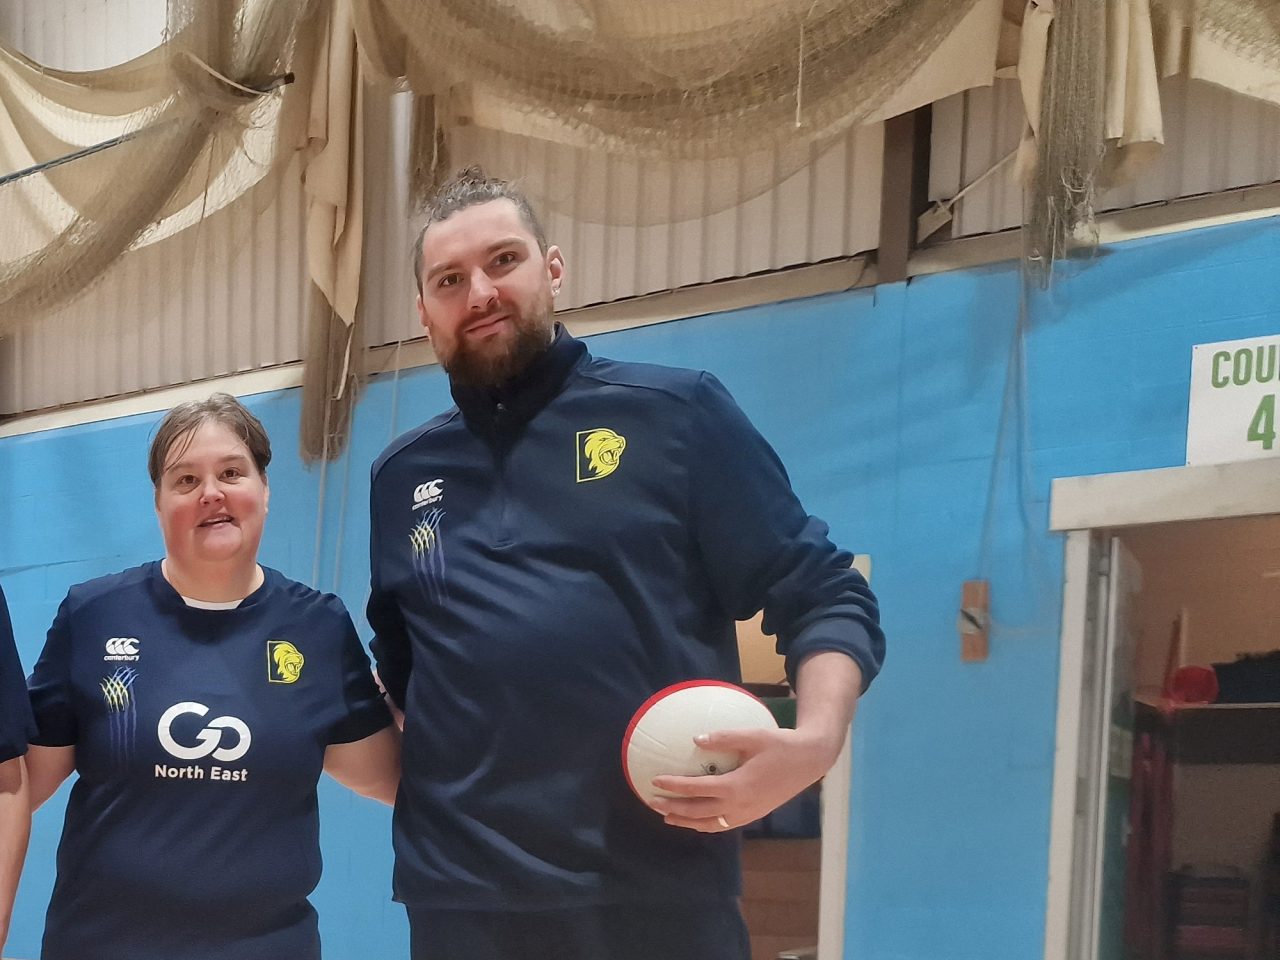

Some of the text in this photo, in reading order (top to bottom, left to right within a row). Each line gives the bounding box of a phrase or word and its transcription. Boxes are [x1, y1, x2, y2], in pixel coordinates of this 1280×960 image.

[1211, 344, 1280, 389] COU
[1247, 394, 1276, 450] 4
[154, 764, 249, 782] North East
